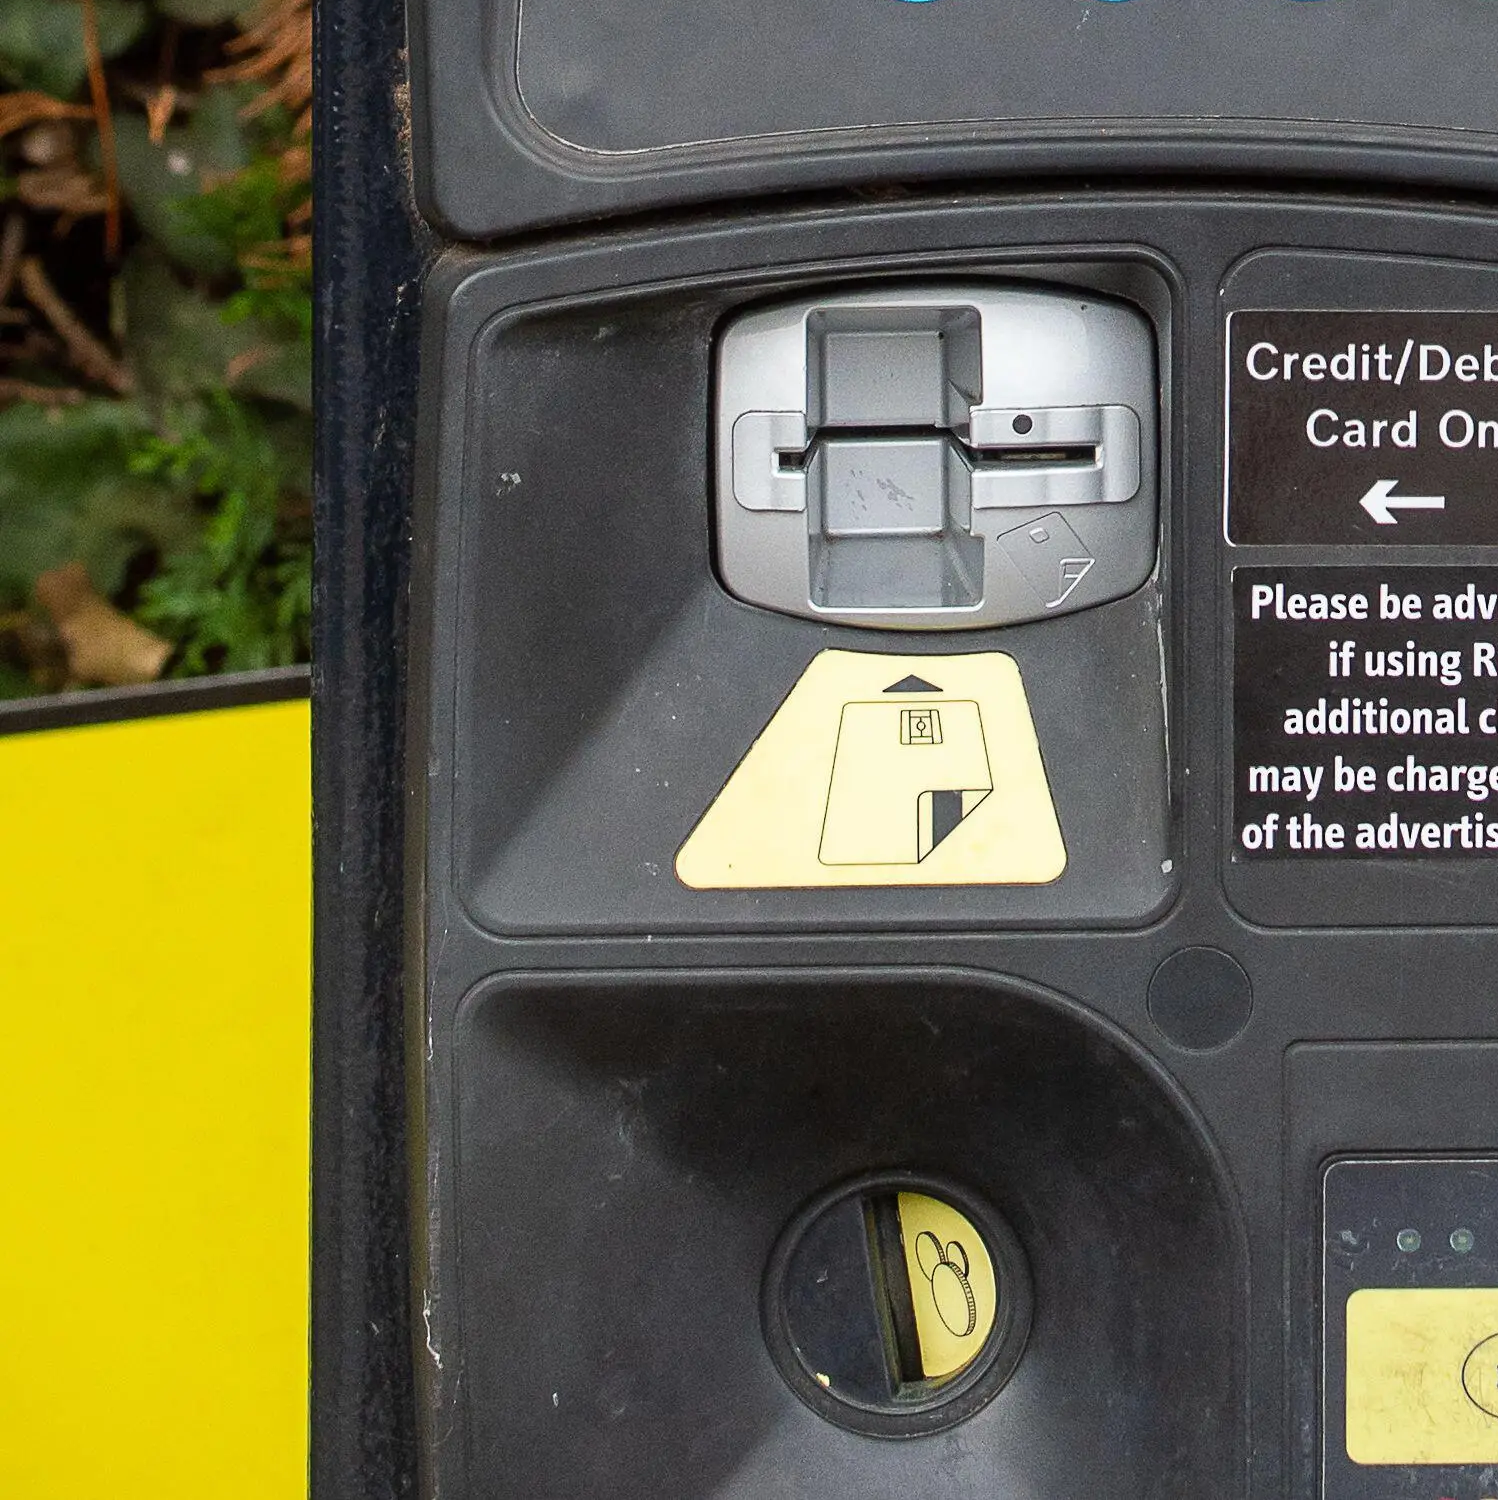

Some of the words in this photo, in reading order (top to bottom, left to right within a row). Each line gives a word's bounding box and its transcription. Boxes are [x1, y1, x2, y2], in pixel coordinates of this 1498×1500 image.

[1305, 408, 1417, 448] Card
[1251, 583, 1369, 620] Please
[1379, 583, 1422, 620] be
[1328, 640, 1356, 677] if
[1364, 640, 1462, 686] using
[1283, 697, 1470, 735] additional
[1249, 765, 1324, 802] may
[1334, 755, 1377, 792] be
[1241, 812, 1280, 850] of
[1285, 812, 1345, 850] the
